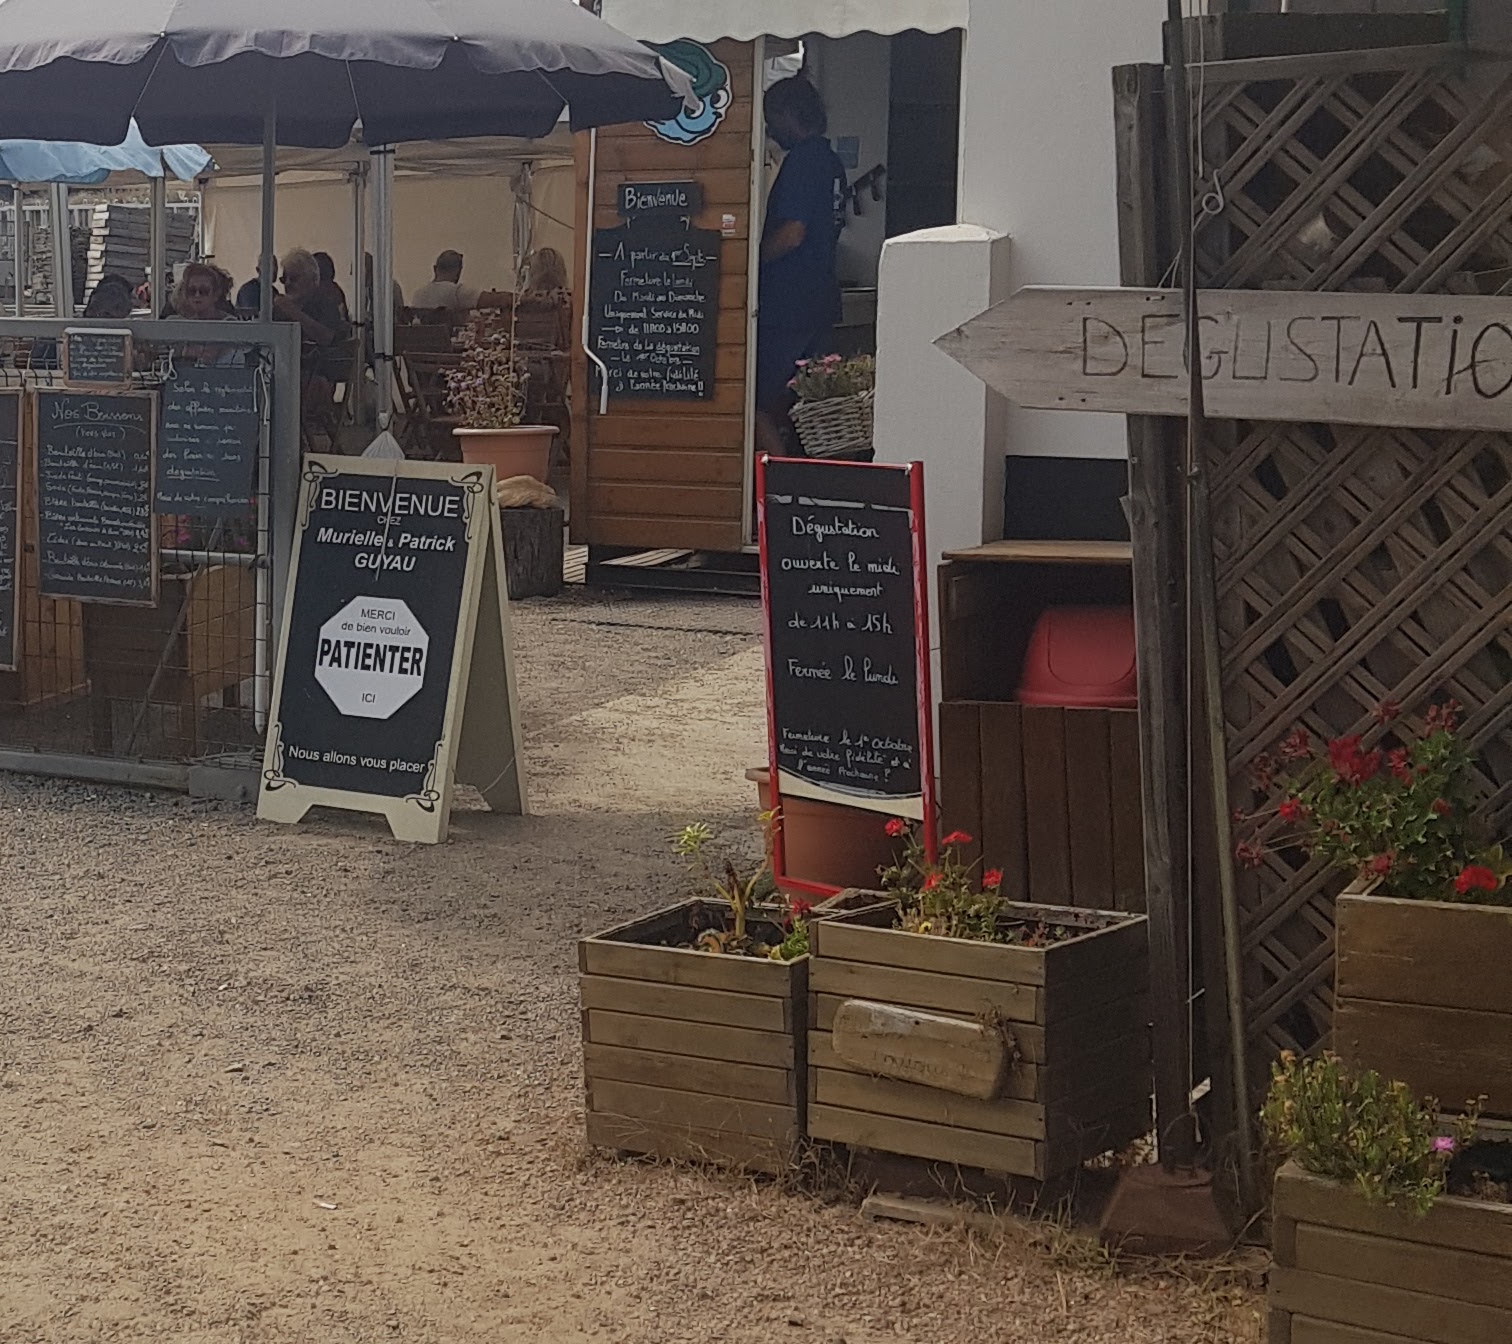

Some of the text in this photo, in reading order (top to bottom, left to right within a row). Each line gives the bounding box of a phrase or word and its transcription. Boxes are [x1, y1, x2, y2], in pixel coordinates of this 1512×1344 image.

[624, 186, 688, 210] Bienvenue
[630, 247, 658, 269] partir
[620, 269, 662, 287] Fermeture
[668, 289, 707, 303] Dimanche
[604, 303, 647, 324] Uniquement
[51, 398, 80, 420] Nos
[321, 488, 461, 517] BIENVENUE
[377, 515, 402, 526] CHEZ
[792, 514, 879, 543] Dégustation
[317, 527, 456, 552] Murielle & Patrick
[354, 552, 417, 572] GUYAU
[781, 550, 901, 575] ouverte le midi
[808, 581, 883, 603] uniquement
[360, 608, 396, 621] MERCI
[787, 610, 808, 629] de
[810, 610, 840, 630] 11h
[861, 610, 893, 634] 15h
[341, 622, 412, 637] de bien vouloir
[318, 639, 424, 677] PATIENTER
[787, 654, 899, 684] Fermée le lundi
[361, 692, 376, 704] ICI
[782, 727, 913, 754] Fermeture le Octobre
[288, 745, 426, 774] Nous allons vous placer
[802, 745, 814, 757] de
[816, 748, 841, 761] votre
[845, 748, 886, 768] fidélité
